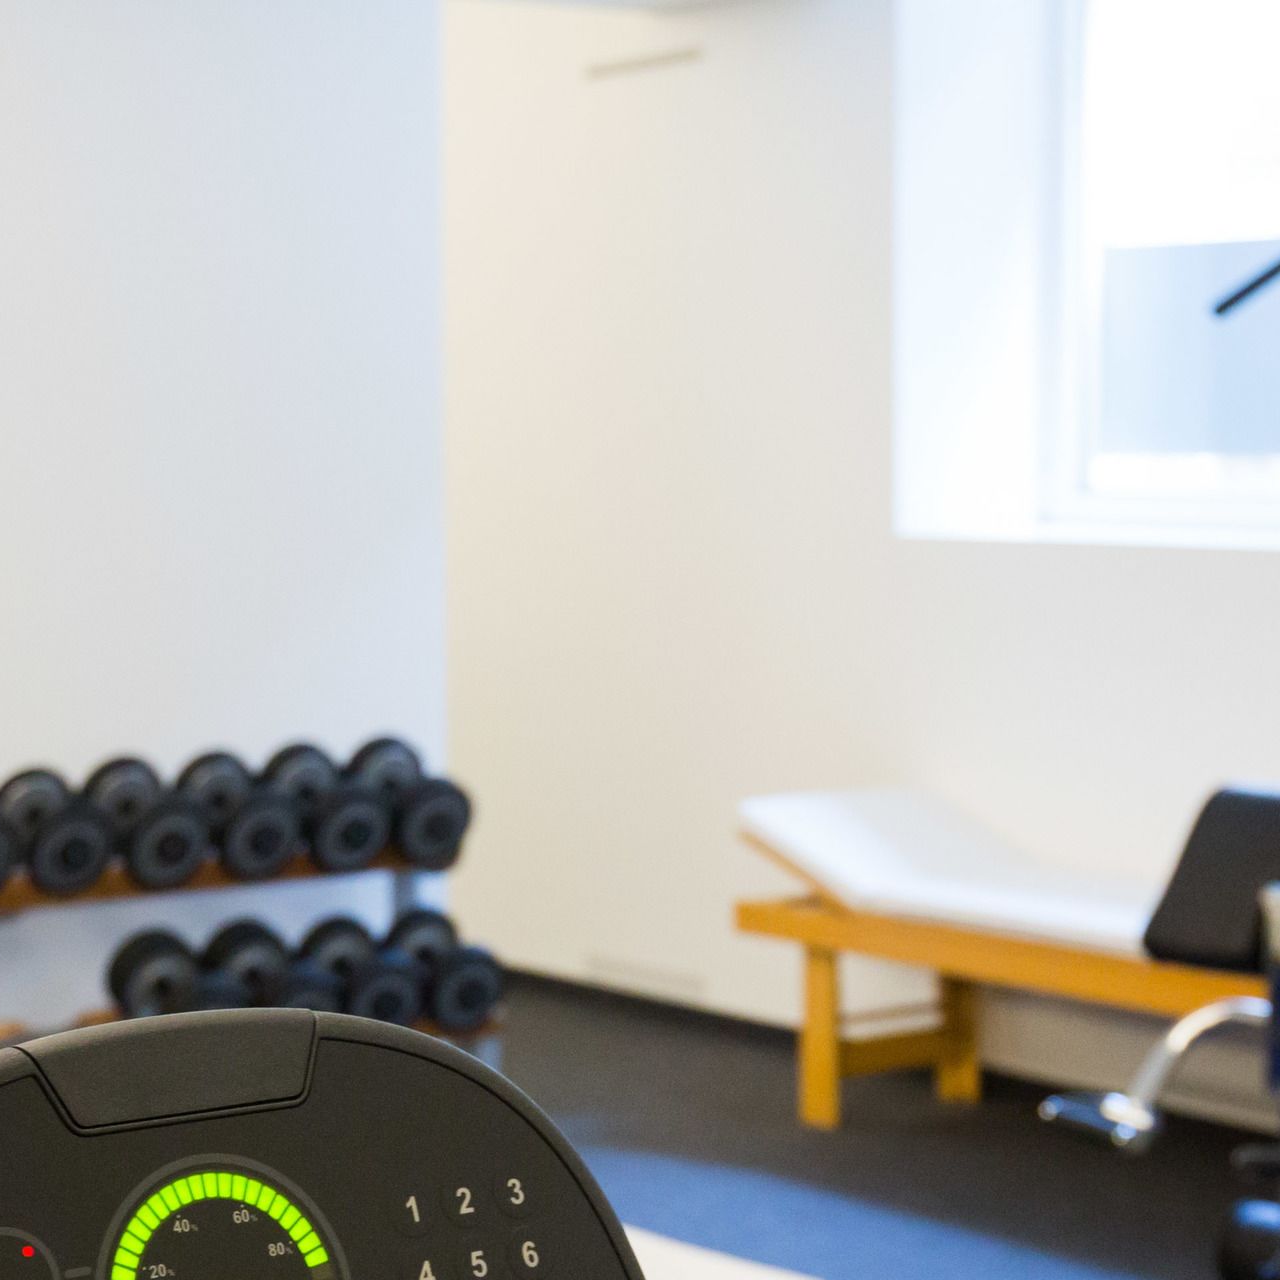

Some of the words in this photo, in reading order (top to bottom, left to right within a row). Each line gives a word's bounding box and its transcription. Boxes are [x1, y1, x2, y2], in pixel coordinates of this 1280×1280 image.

[405, 1195, 420, 1223] 1
[455, 1187, 475, 1215] 2
[507, 1178, 525, 1205] 3
[232, 1209, 258, 1224] 60%
[173, 1219, 198, 1233] 40%
[268, 1242, 292, 1257] 80%
[471, 1250, 488, 1278] 5
[522, 1241, 540, 1268] 6
[150, 1263, 175, 1279] 20%
